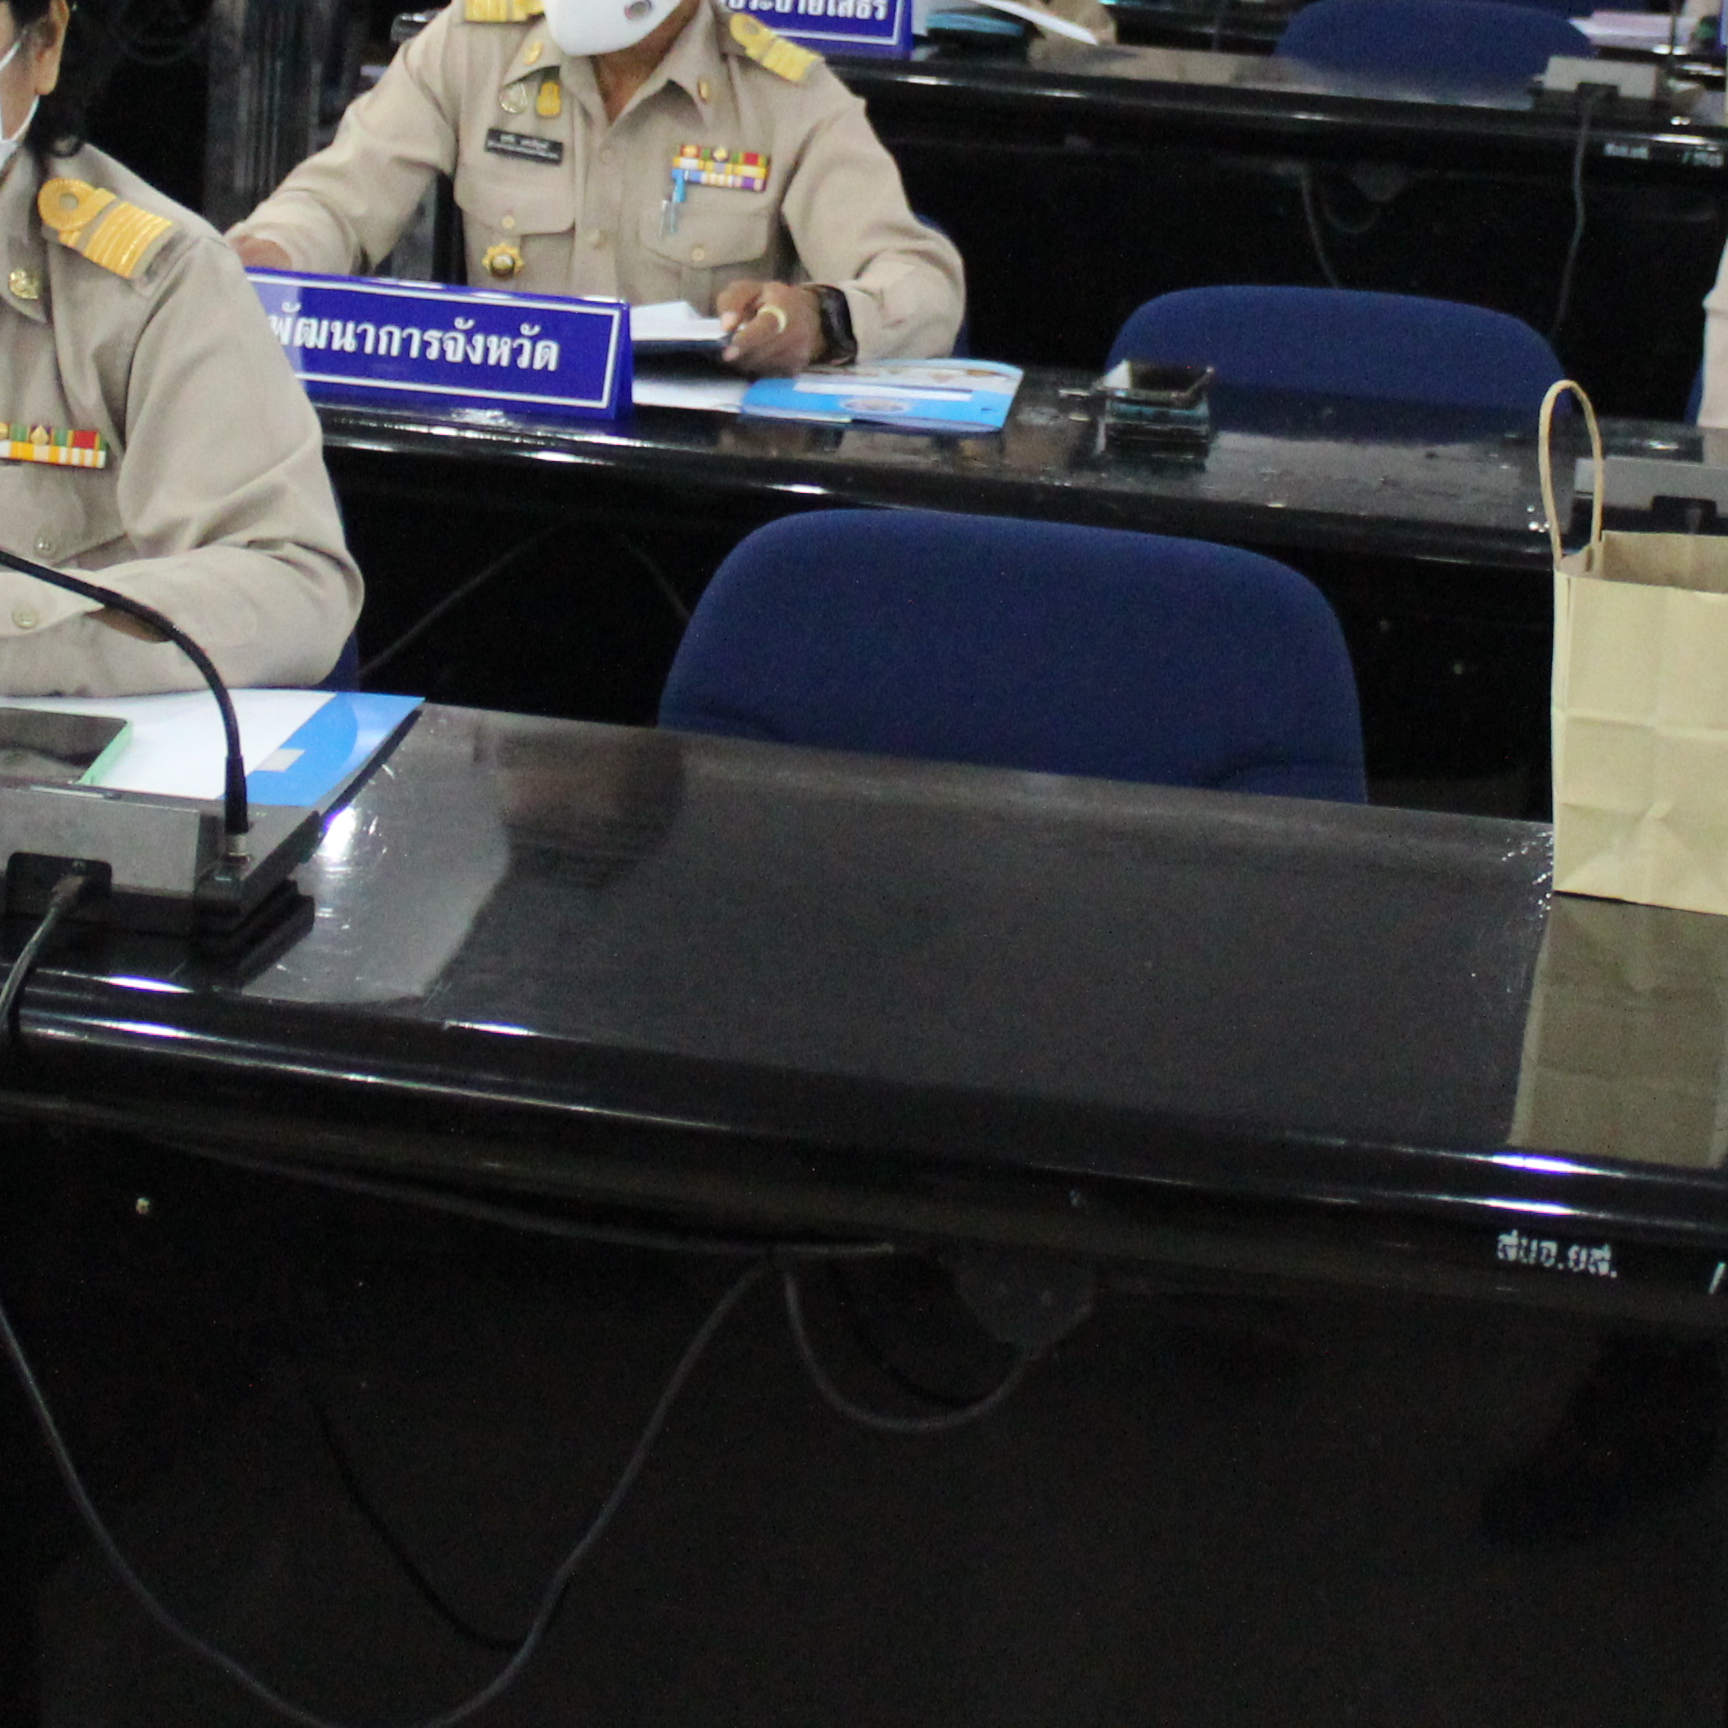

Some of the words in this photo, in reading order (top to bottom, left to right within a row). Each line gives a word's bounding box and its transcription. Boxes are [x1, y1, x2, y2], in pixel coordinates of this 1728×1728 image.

[268, 301, 560, 372] พัฒนาการจังหวัด
